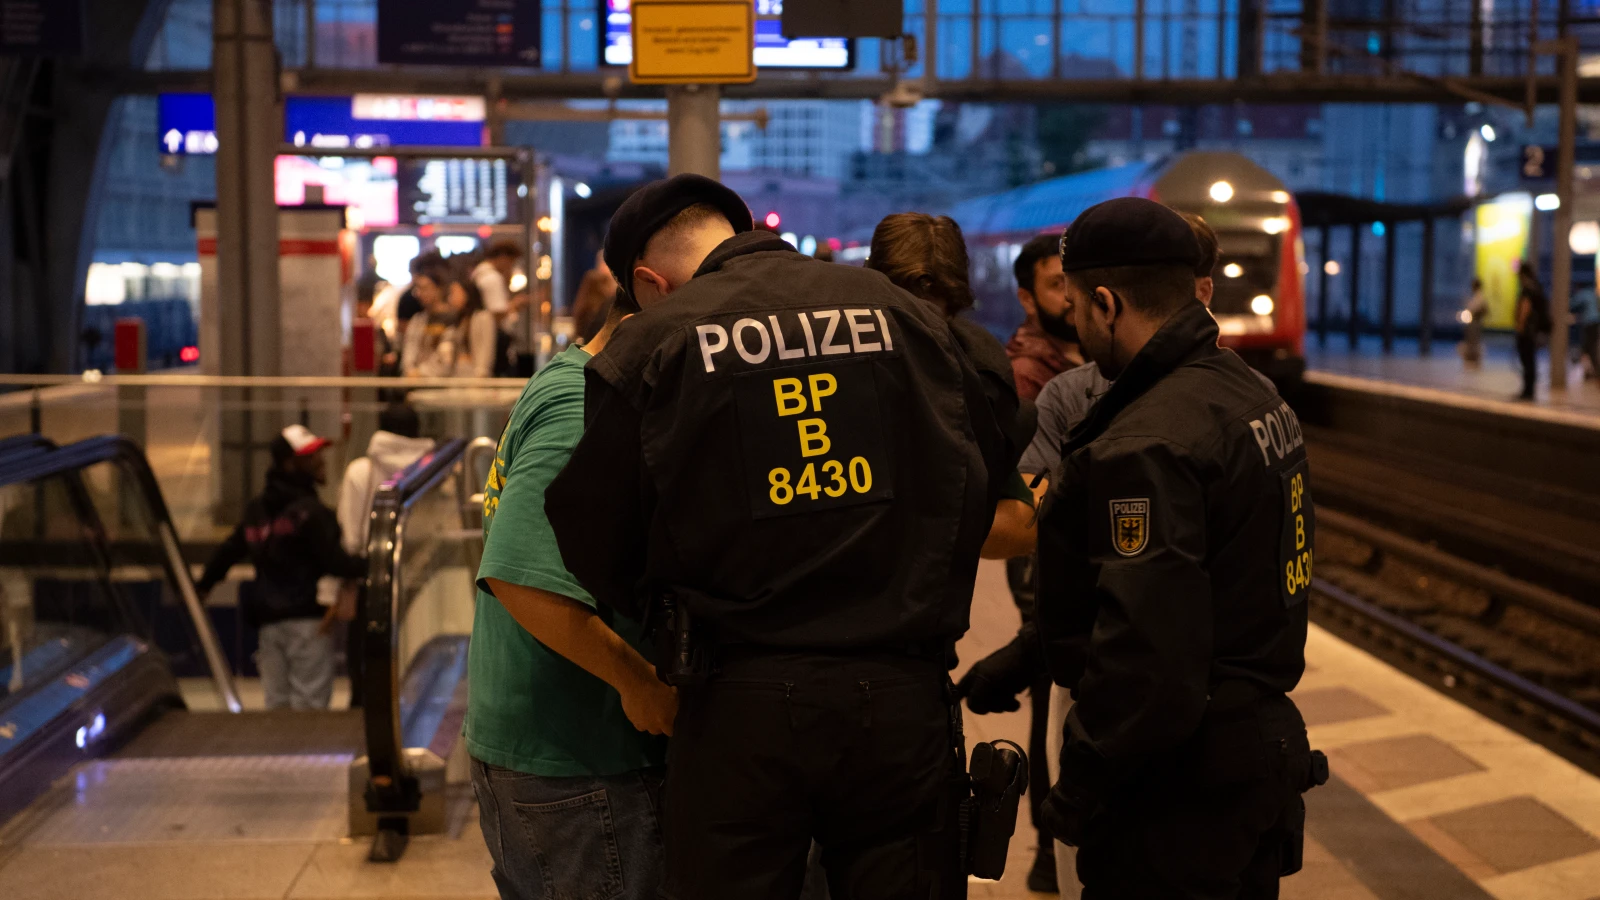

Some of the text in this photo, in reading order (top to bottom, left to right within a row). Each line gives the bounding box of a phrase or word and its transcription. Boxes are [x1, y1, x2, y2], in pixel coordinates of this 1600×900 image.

[1523, 145, 1544, 177] 2
[696, 308, 894, 373] POLIZEI
[772, 373, 838, 417] BP
[797, 417, 832, 458] B
[768, 456, 873, 505] 8430
[1291, 472, 1303, 514] BP
[1113, 502, 1147, 515] POLIZEI
[1295, 514, 1305, 551] B
